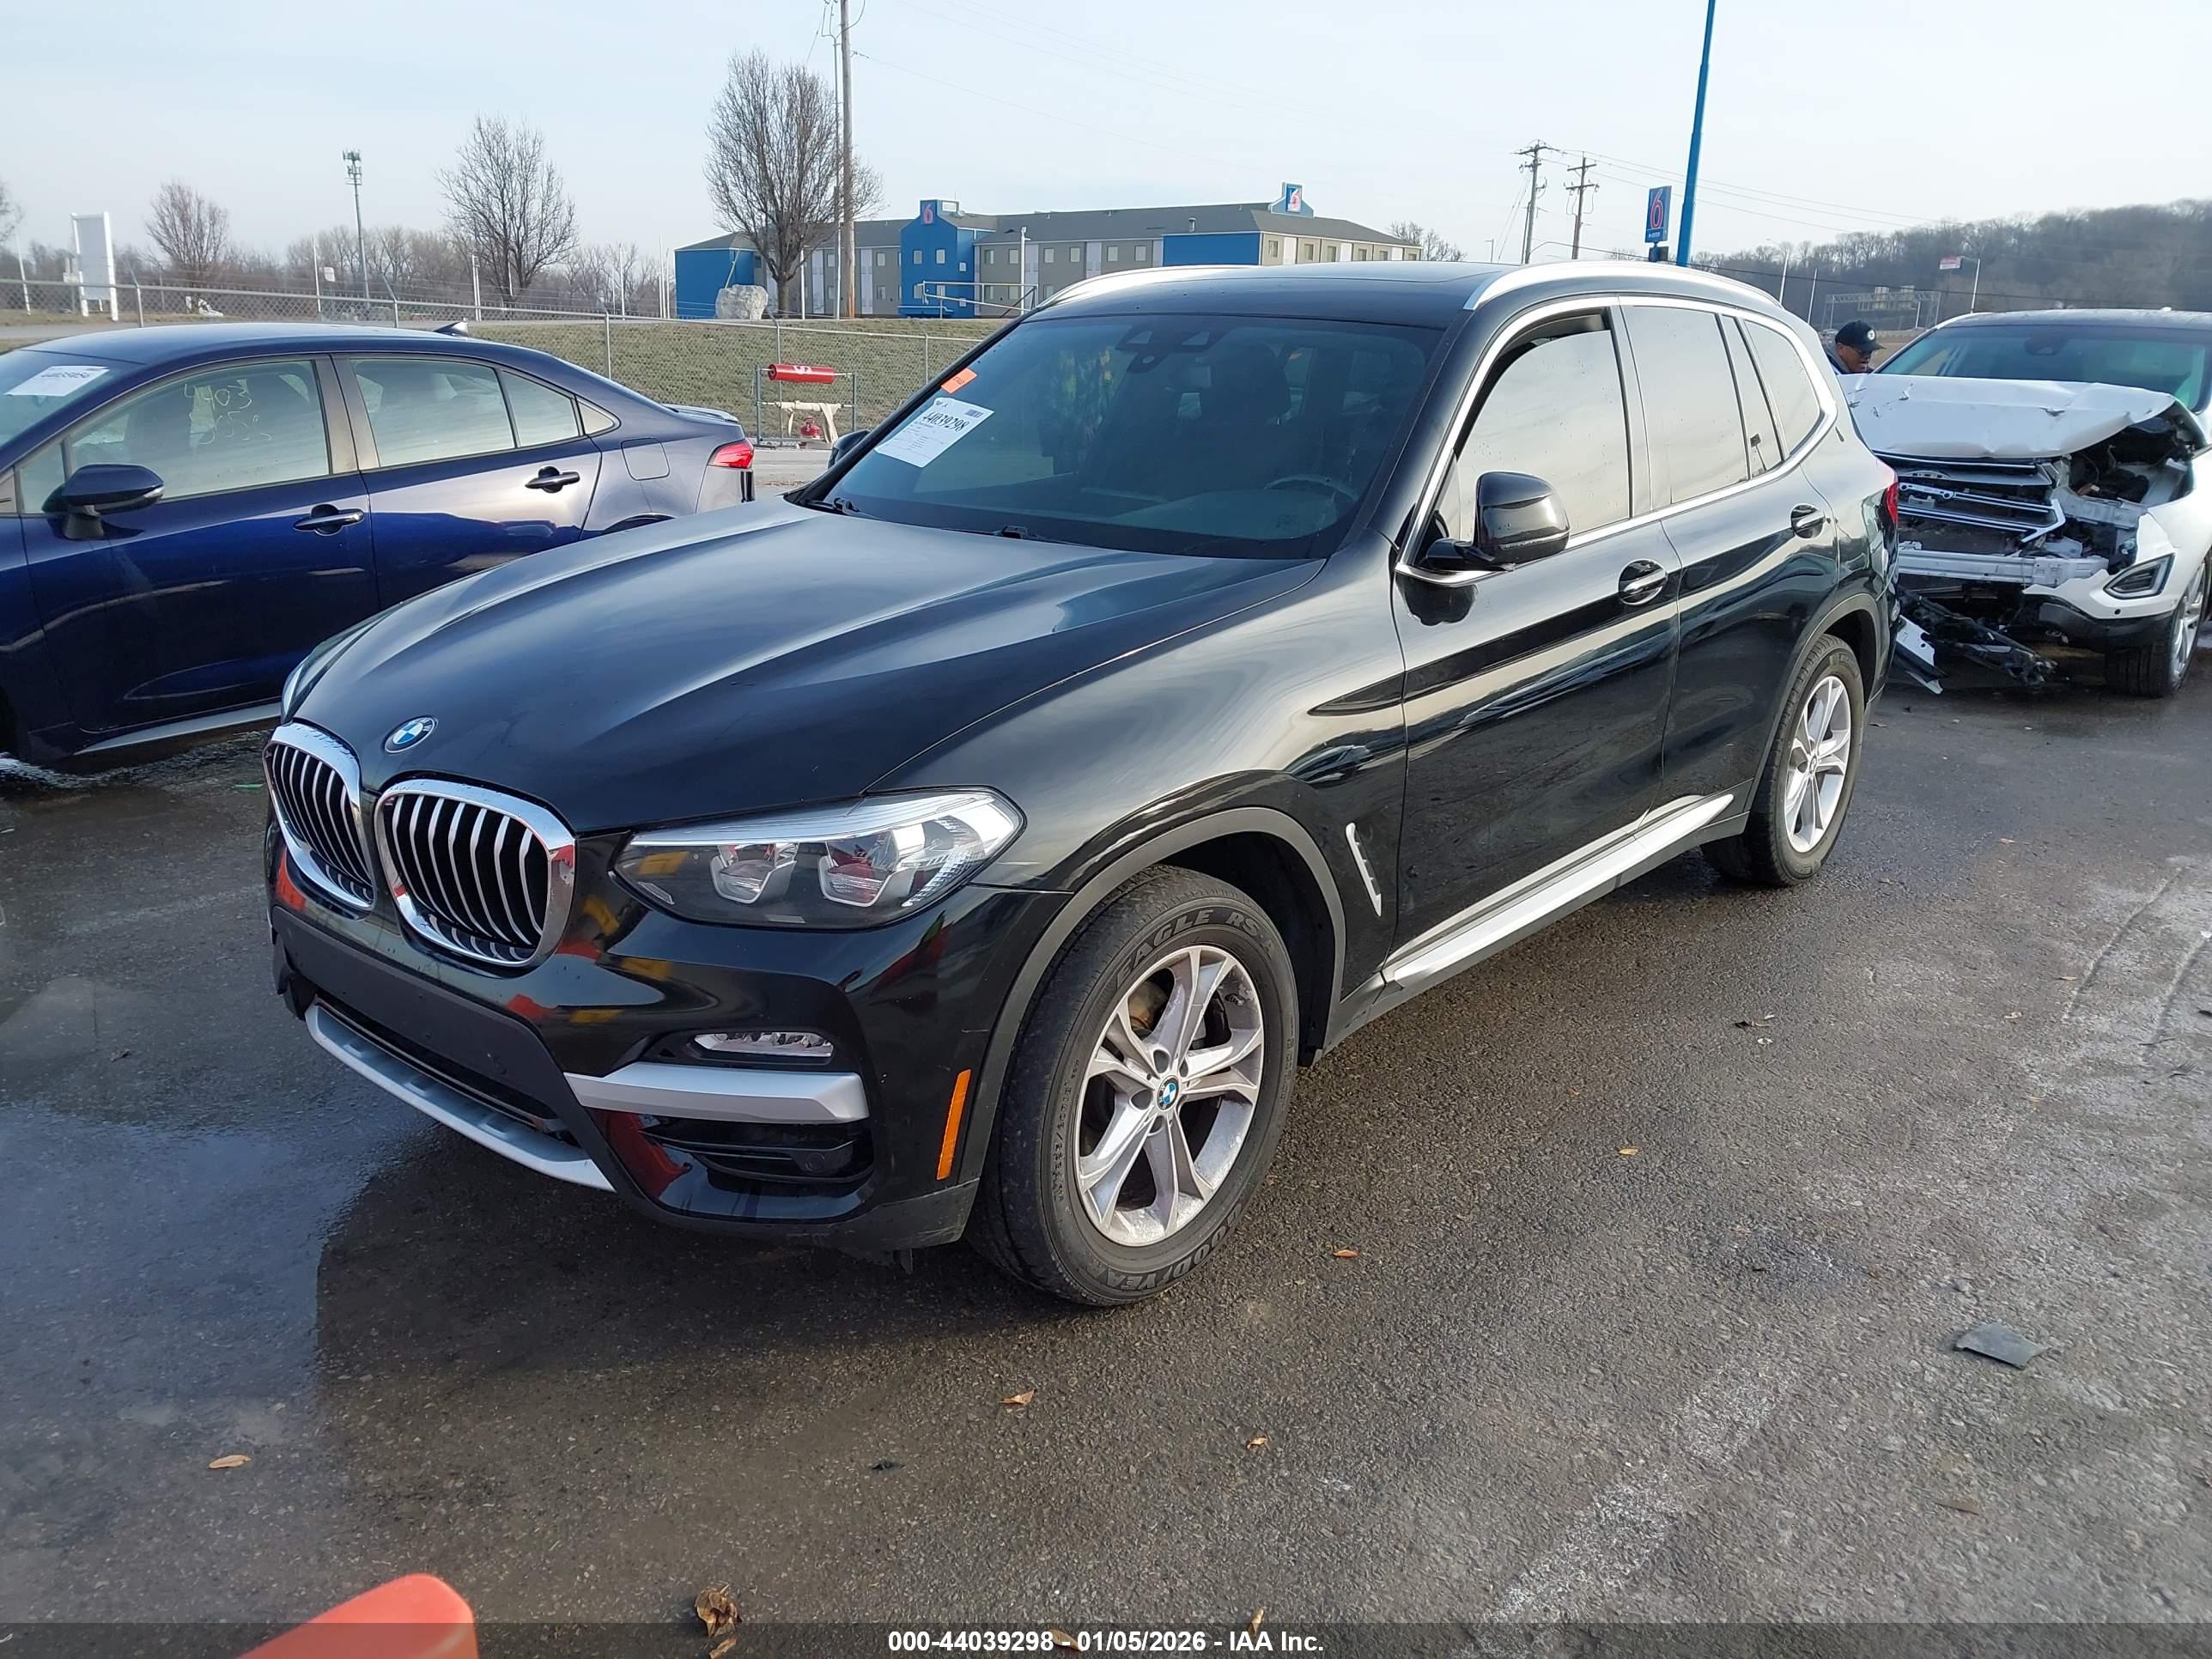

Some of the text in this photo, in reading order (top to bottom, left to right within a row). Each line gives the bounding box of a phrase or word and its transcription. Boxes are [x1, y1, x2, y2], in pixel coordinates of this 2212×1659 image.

[1290, 188, 1300, 211] 6
[1650, 188, 1663, 230] 6
[922, 203, 933, 225] 6
[921, 411, 972, 433] 44039298
[1115, 908, 1214, 989] EAGLE
